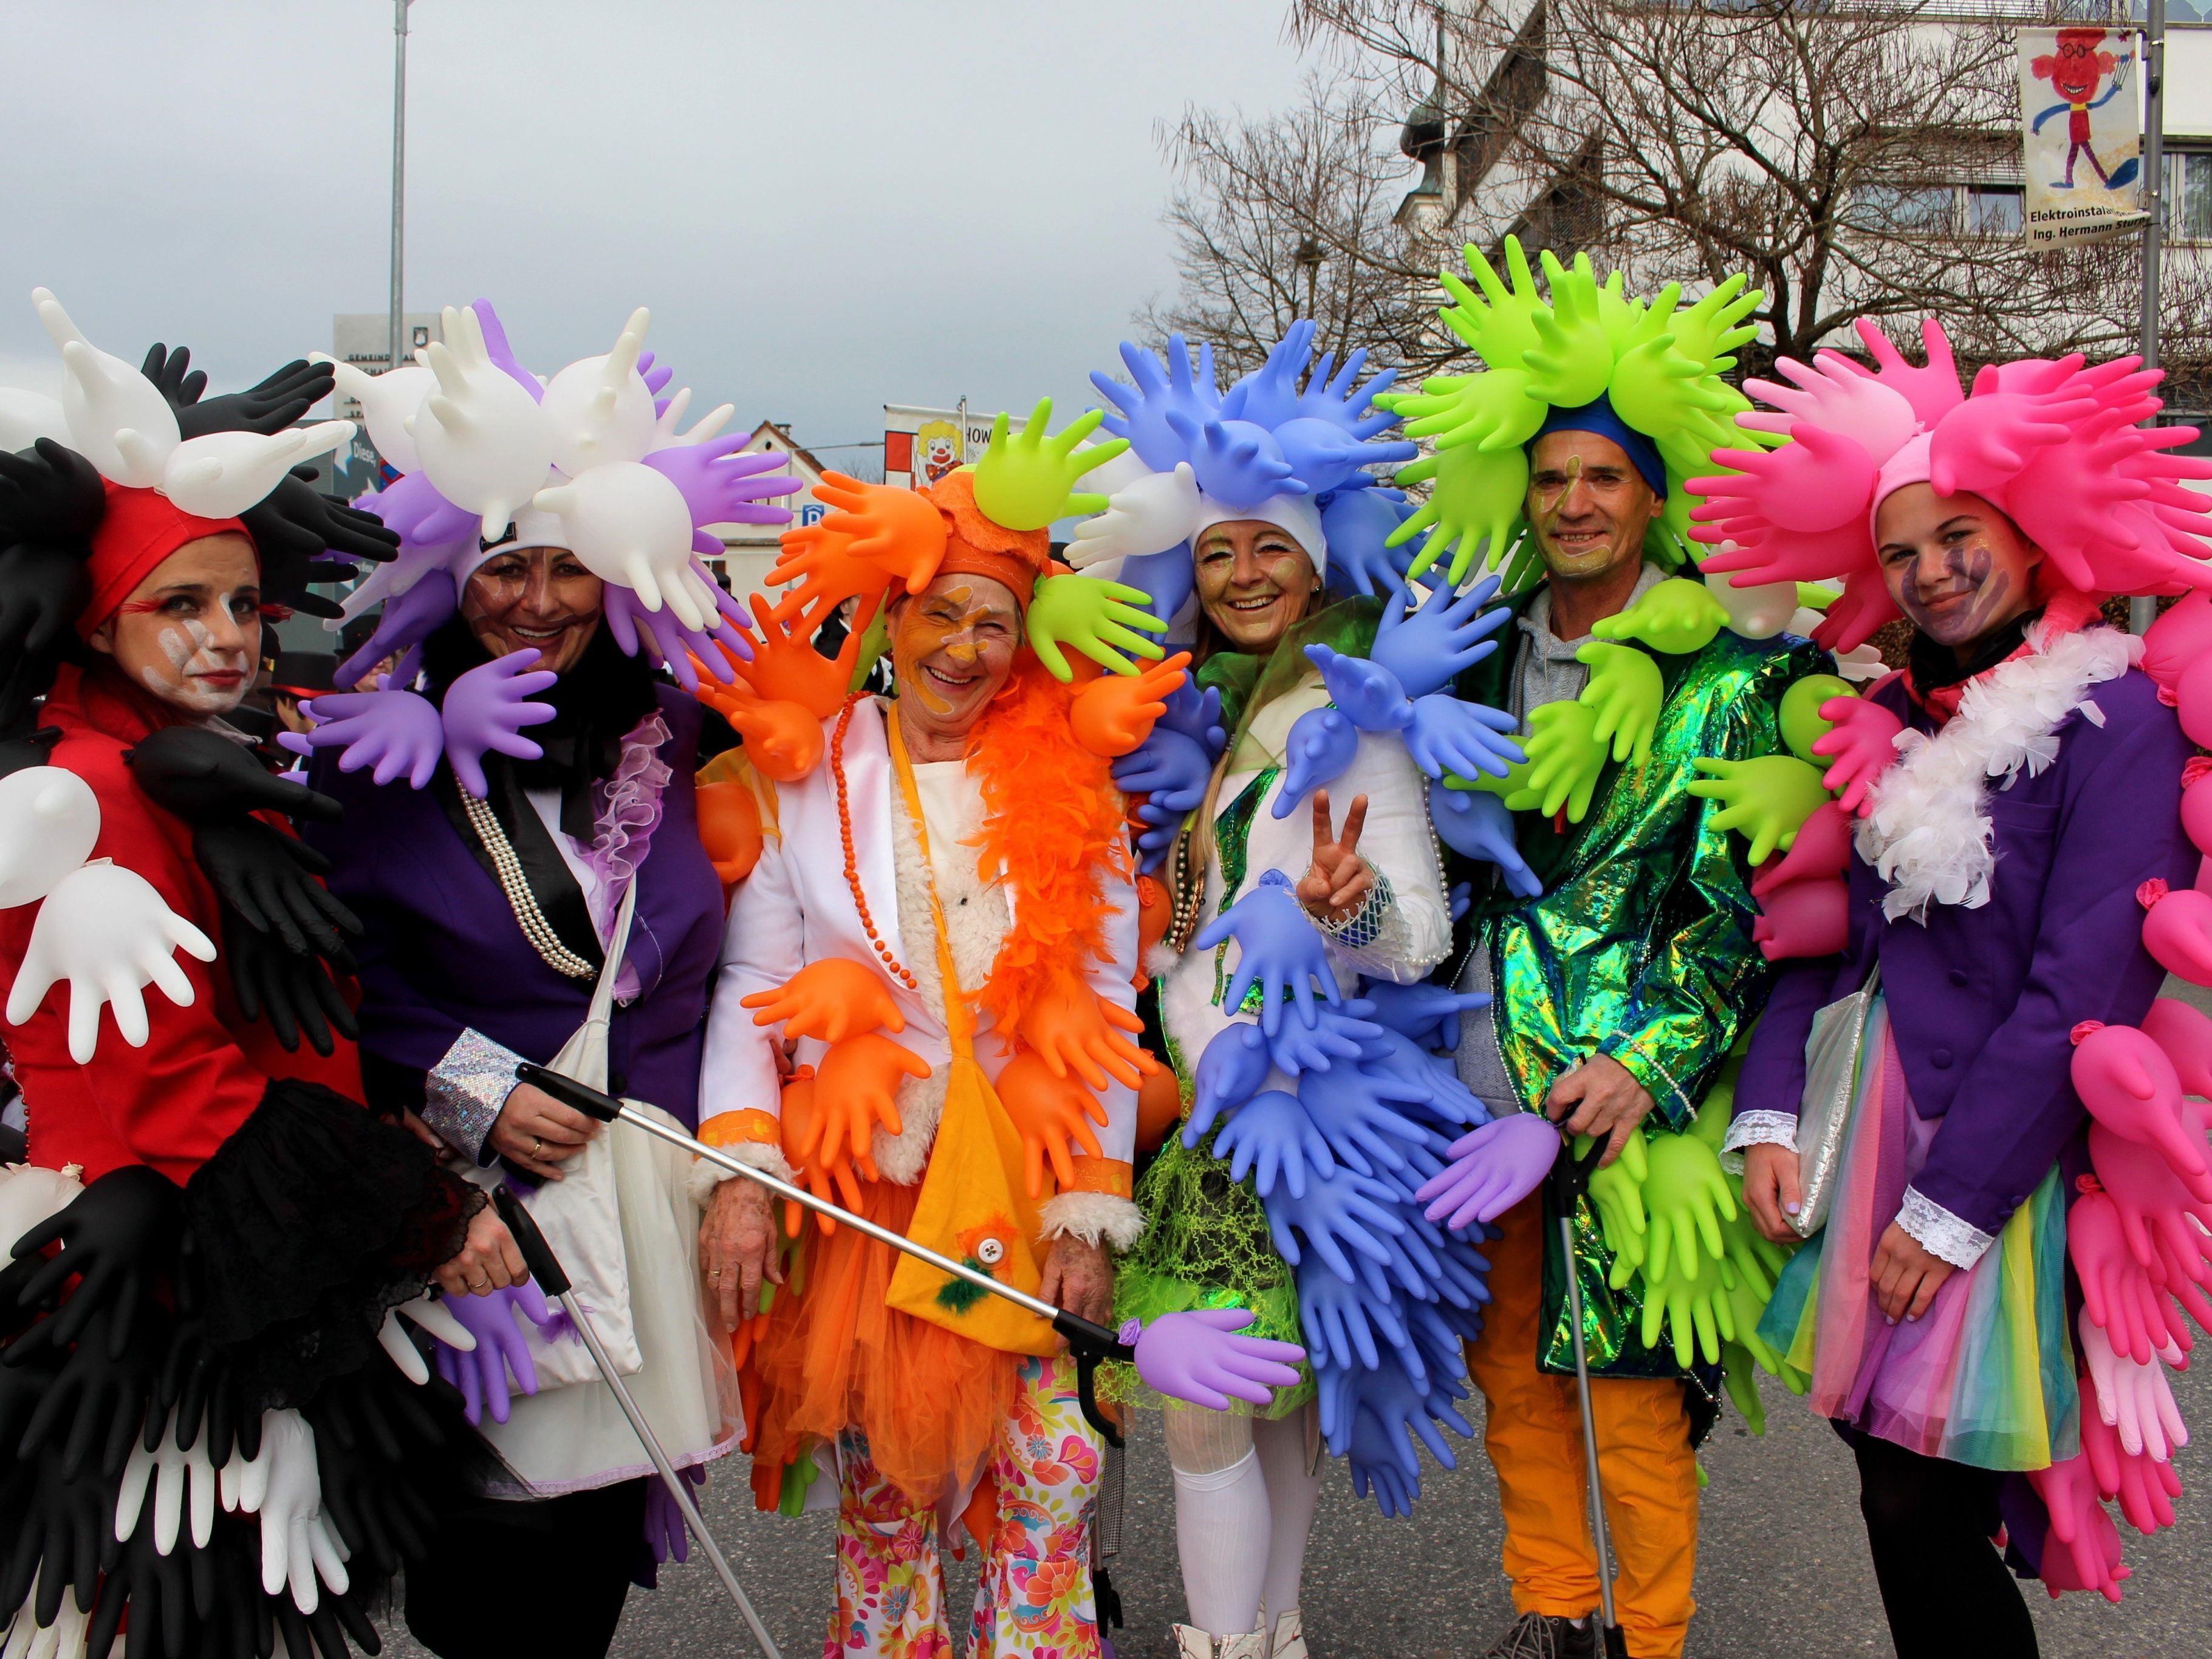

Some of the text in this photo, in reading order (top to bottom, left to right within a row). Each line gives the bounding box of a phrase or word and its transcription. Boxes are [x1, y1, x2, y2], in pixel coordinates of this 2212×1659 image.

[2033, 229, 2056, 242] Ing.
[2059, 224, 2112, 238] Hermann
[808, 511, 821, 526] P
